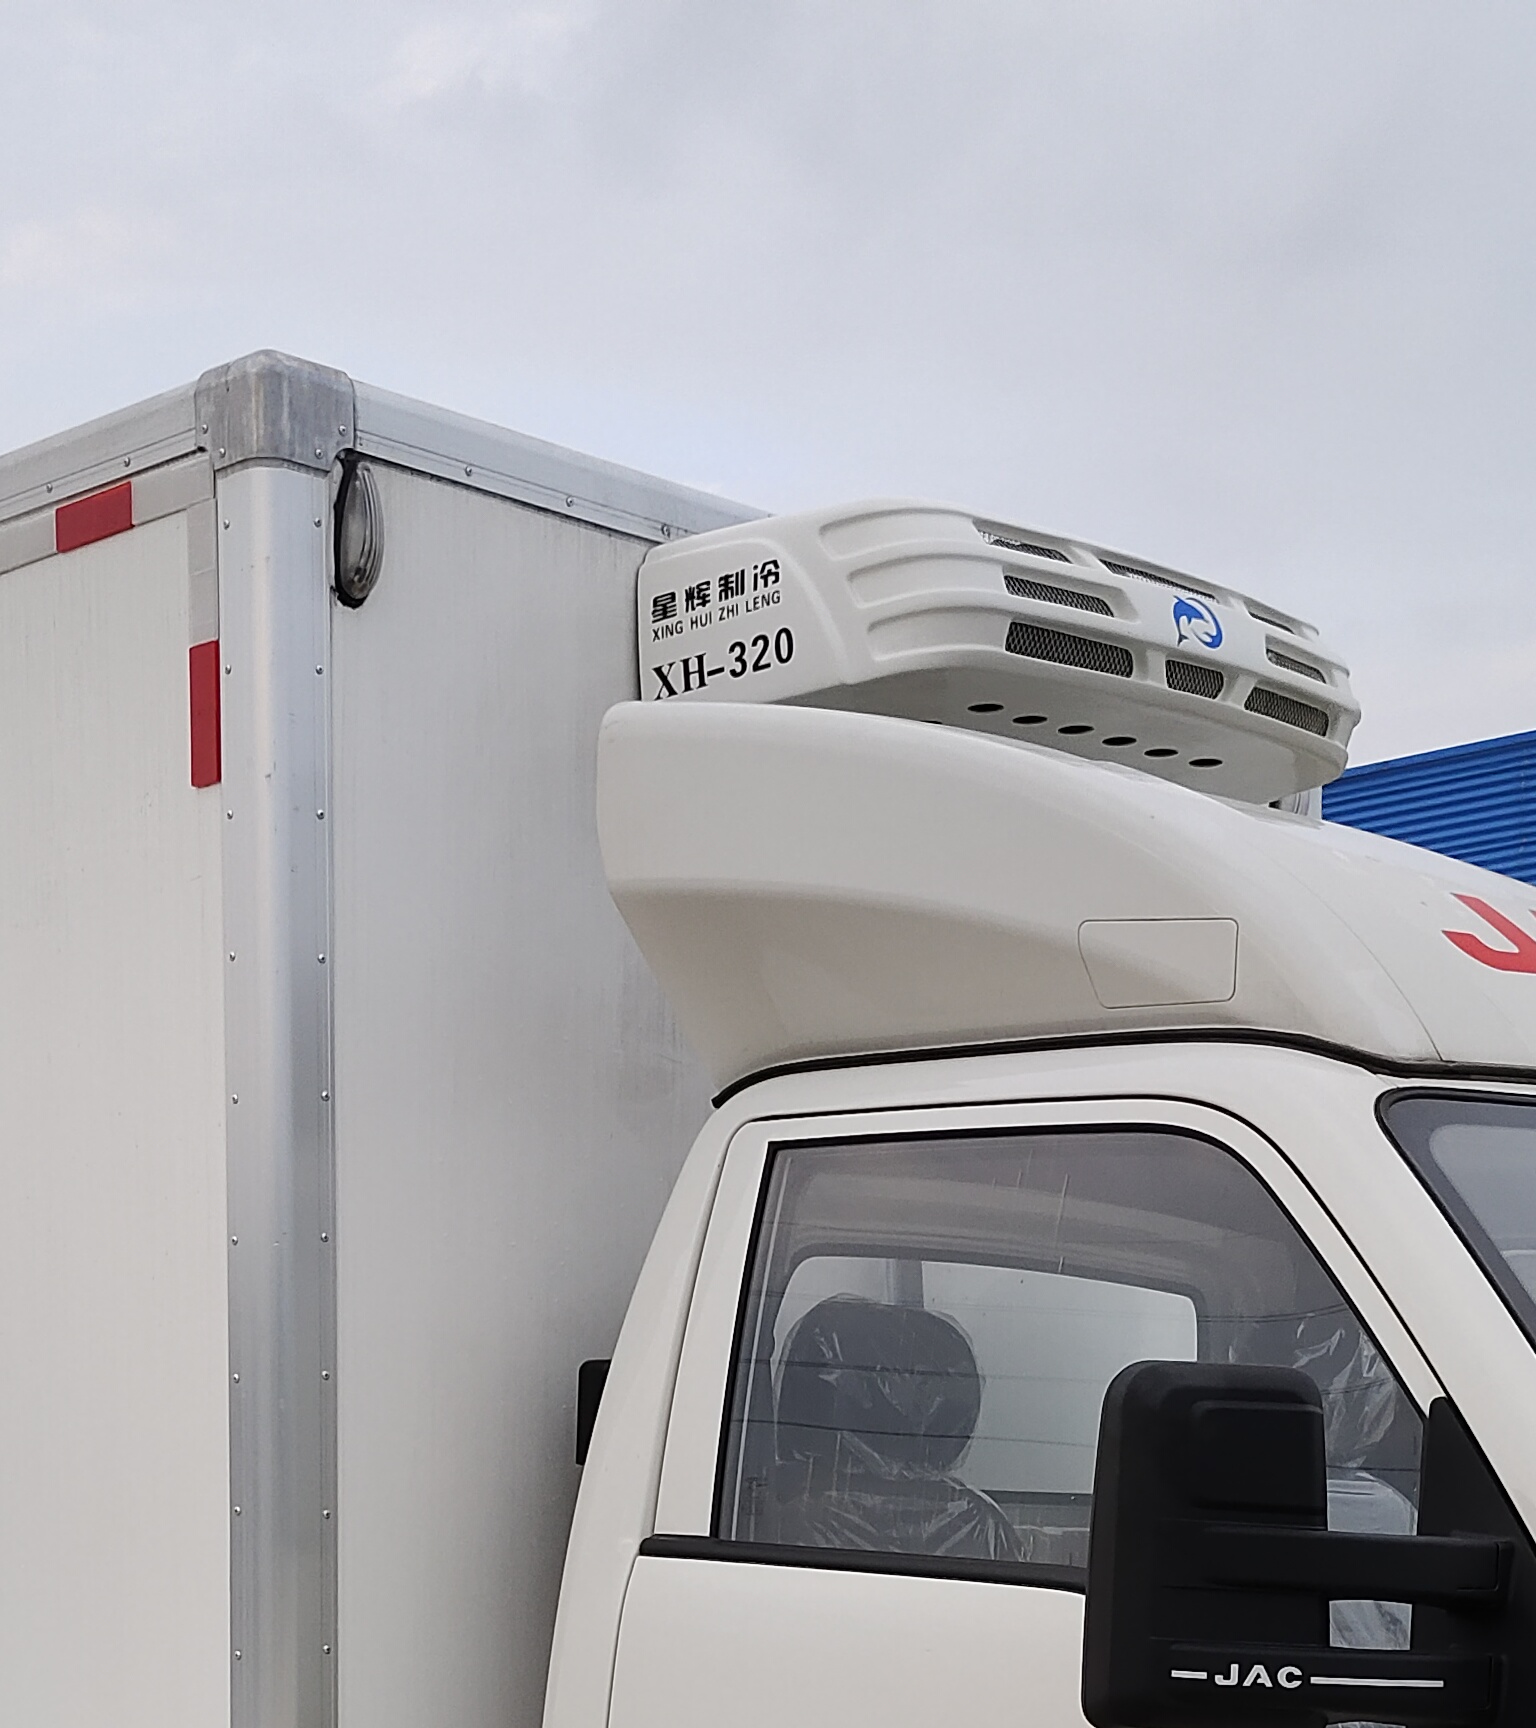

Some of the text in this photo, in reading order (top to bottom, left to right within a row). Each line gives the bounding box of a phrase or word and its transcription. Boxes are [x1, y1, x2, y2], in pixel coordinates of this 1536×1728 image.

[651, 559, 780, 624] 星辉制冷
[652, 590, 781, 643] XING HUI ZHI LENG
[651, 627, 794, 701] XH-320
[1214, 1663, 1303, 1688] JAC
